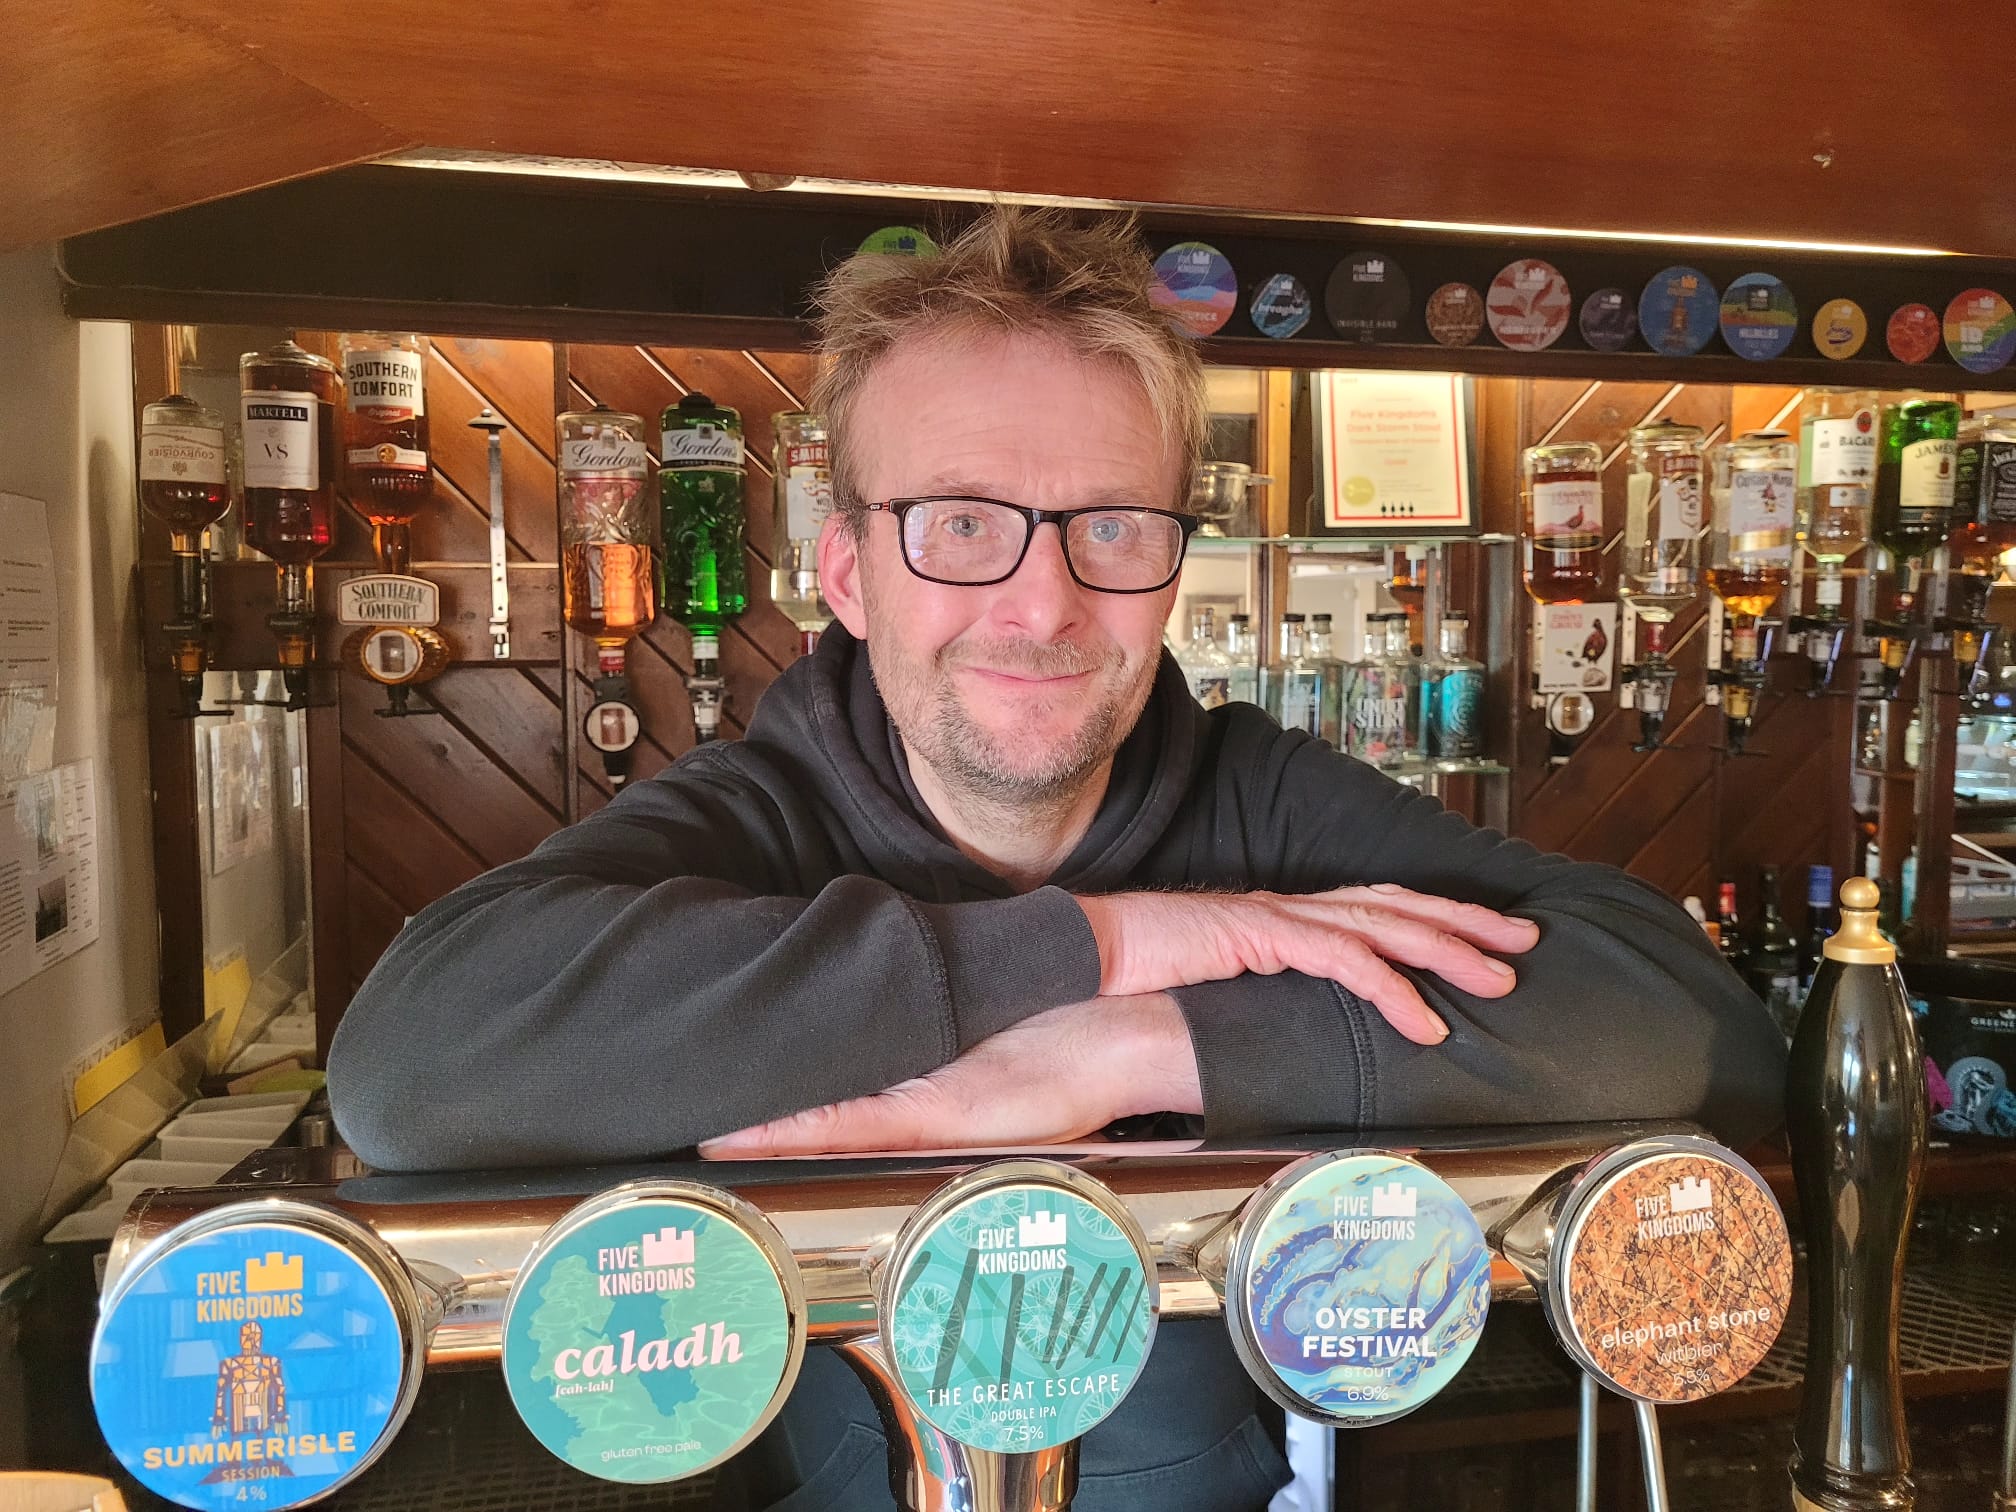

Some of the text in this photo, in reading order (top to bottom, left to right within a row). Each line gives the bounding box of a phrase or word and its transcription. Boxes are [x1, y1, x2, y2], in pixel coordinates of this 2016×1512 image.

[349, 361, 418, 381] SOUTHERN
[353, 380, 414, 398] COMFORT
[248, 406, 308, 420] MARTELL
[264, 442, 289, 459] VS
[352, 581, 428, 603] SOUTHERN
[358, 600, 419, 620] COMFORT
[1333, 1195, 1368, 1217] FIVE
[1634, 1195, 1668, 1218] FIVE
[1333, 1219, 1416, 1241] KINGDOMS
[1637, 1211, 1715, 1241] KINGDOMS
[978, 1227, 1016, 1250] FIVE
[598, 1245, 639, 1271] FIVE
[978, 1248, 1067, 1275] KINGDOMS
[197, 1270, 241, 1297] FIVE
[599, 1267, 696, 1297] KINGDOMS
[197, 1293, 303, 1323] KINGDOMS
[1315, 1306, 1427, 1330] OYSTER
[1601, 1306, 1772, 1350] elephant stone
[554, 1320, 744, 1381] caladh
[1303, 1335, 1438, 1359] FESTIVAL
[1655, 1341, 1723, 1365] witbier
[1343, 1366, 1393, 1379] STOUT
[927, 1373, 1120, 1408] THE GREAT ESCAPE
[1347, 1385, 1390, 1401] 6.9%
[991, 1405, 1057, 1423] DOUBLE IPA
[1003, 1425, 1044, 1442] 7.5%
[143, 1430, 356, 1469] SUMMERISLE
[600, 1439, 702, 1463] gluten free pale
[222, 1465, 280, 1482] SESSION
